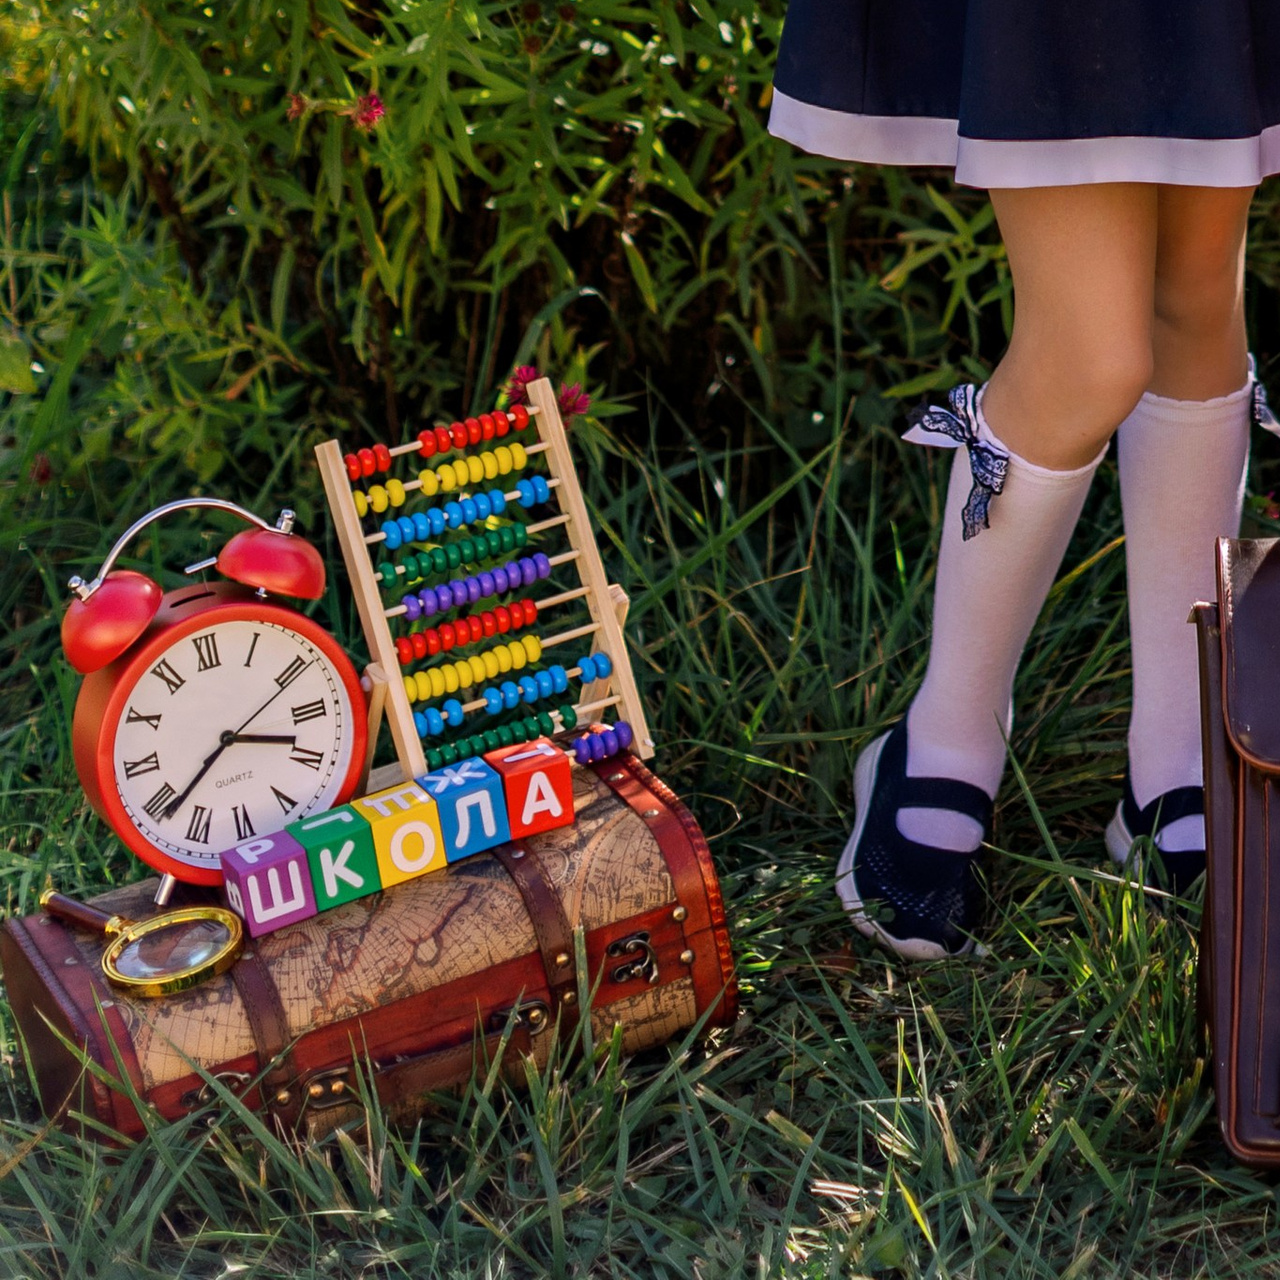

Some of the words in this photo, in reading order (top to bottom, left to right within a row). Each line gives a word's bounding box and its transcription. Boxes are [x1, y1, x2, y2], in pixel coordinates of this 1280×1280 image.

[191, 632, 222, 672] XII
[150, 657, 187, 696] XI
[125, 706, 162, 731] X
[291, 697, 327, 726] III
[215, 770, 254, 789] QUARTZ
[424, 761, 487, 794] Ж
[270, 785, 298, 816] V
[247, 771, 563, 924] ШКОЛА
